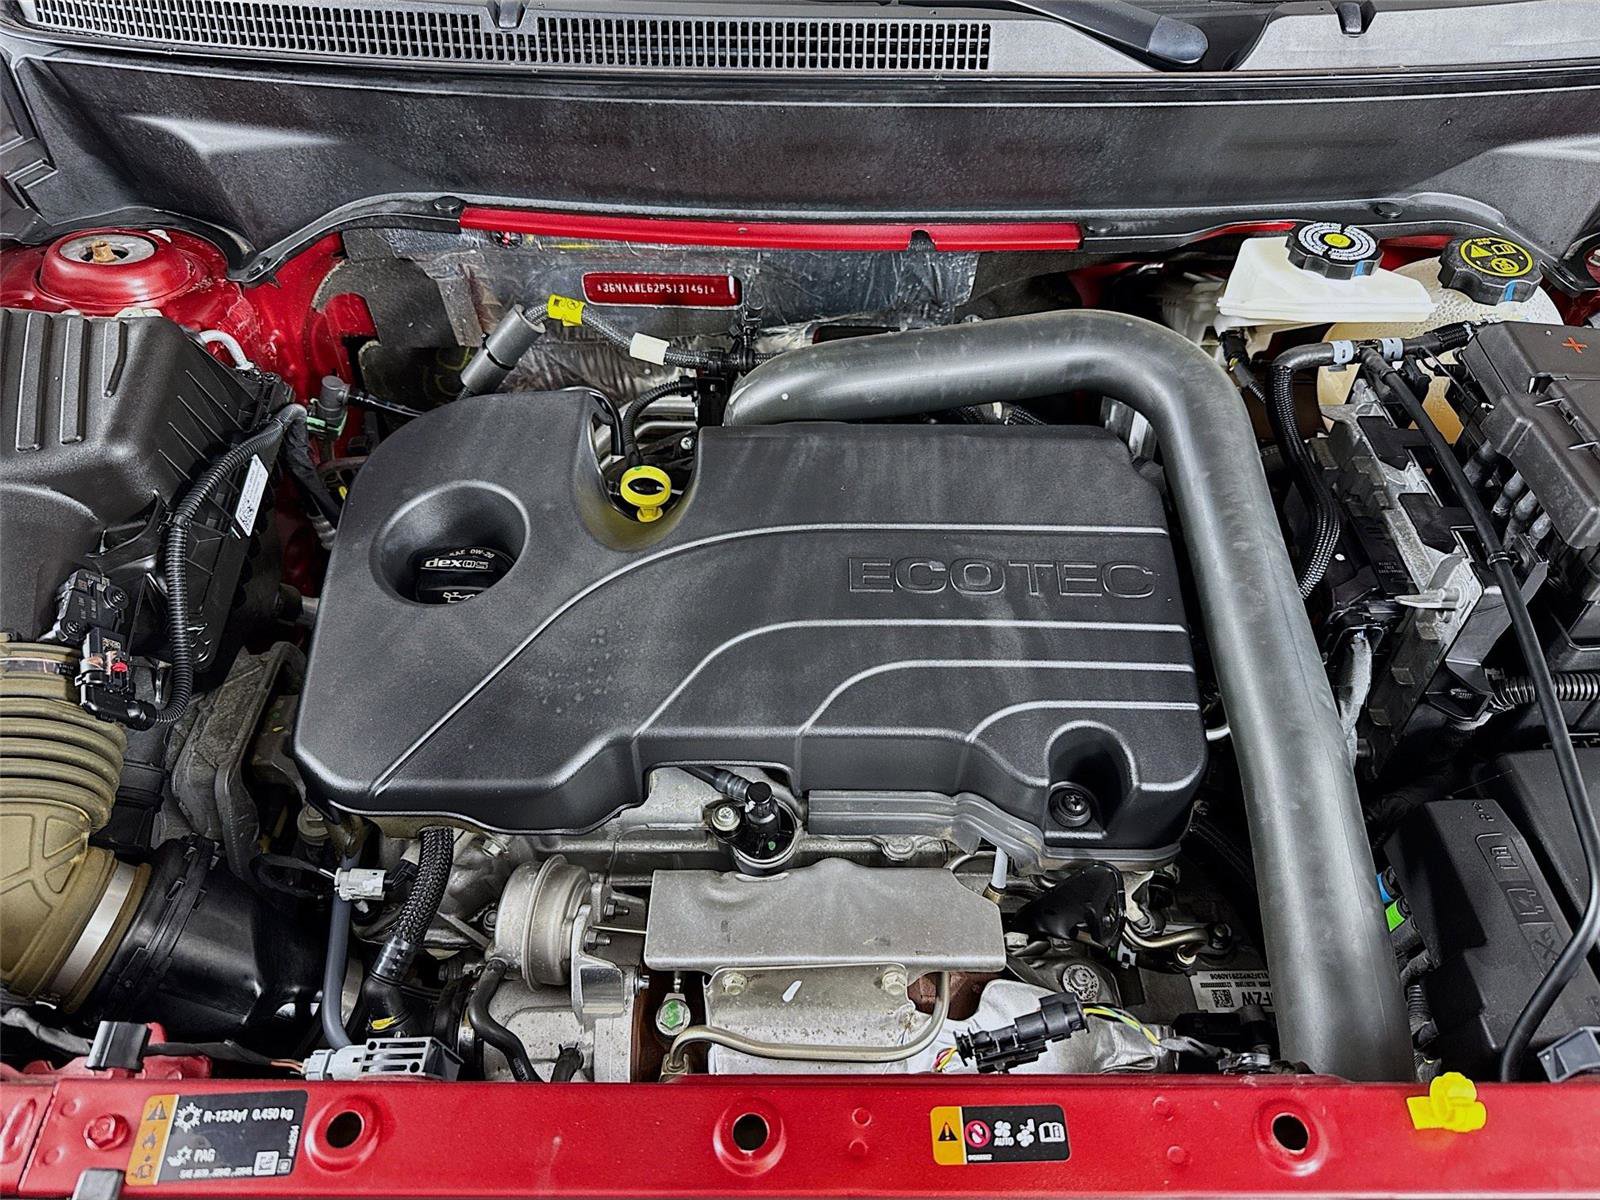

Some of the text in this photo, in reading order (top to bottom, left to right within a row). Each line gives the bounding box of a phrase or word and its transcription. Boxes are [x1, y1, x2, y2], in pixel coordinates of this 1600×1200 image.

[425, 558, 489, 570] dexos
[848, 557, 1156, 599] ECOTEC
[1241, 991, 1275, 1007] FZW
[193, 1148, 216, 1163] PAG
